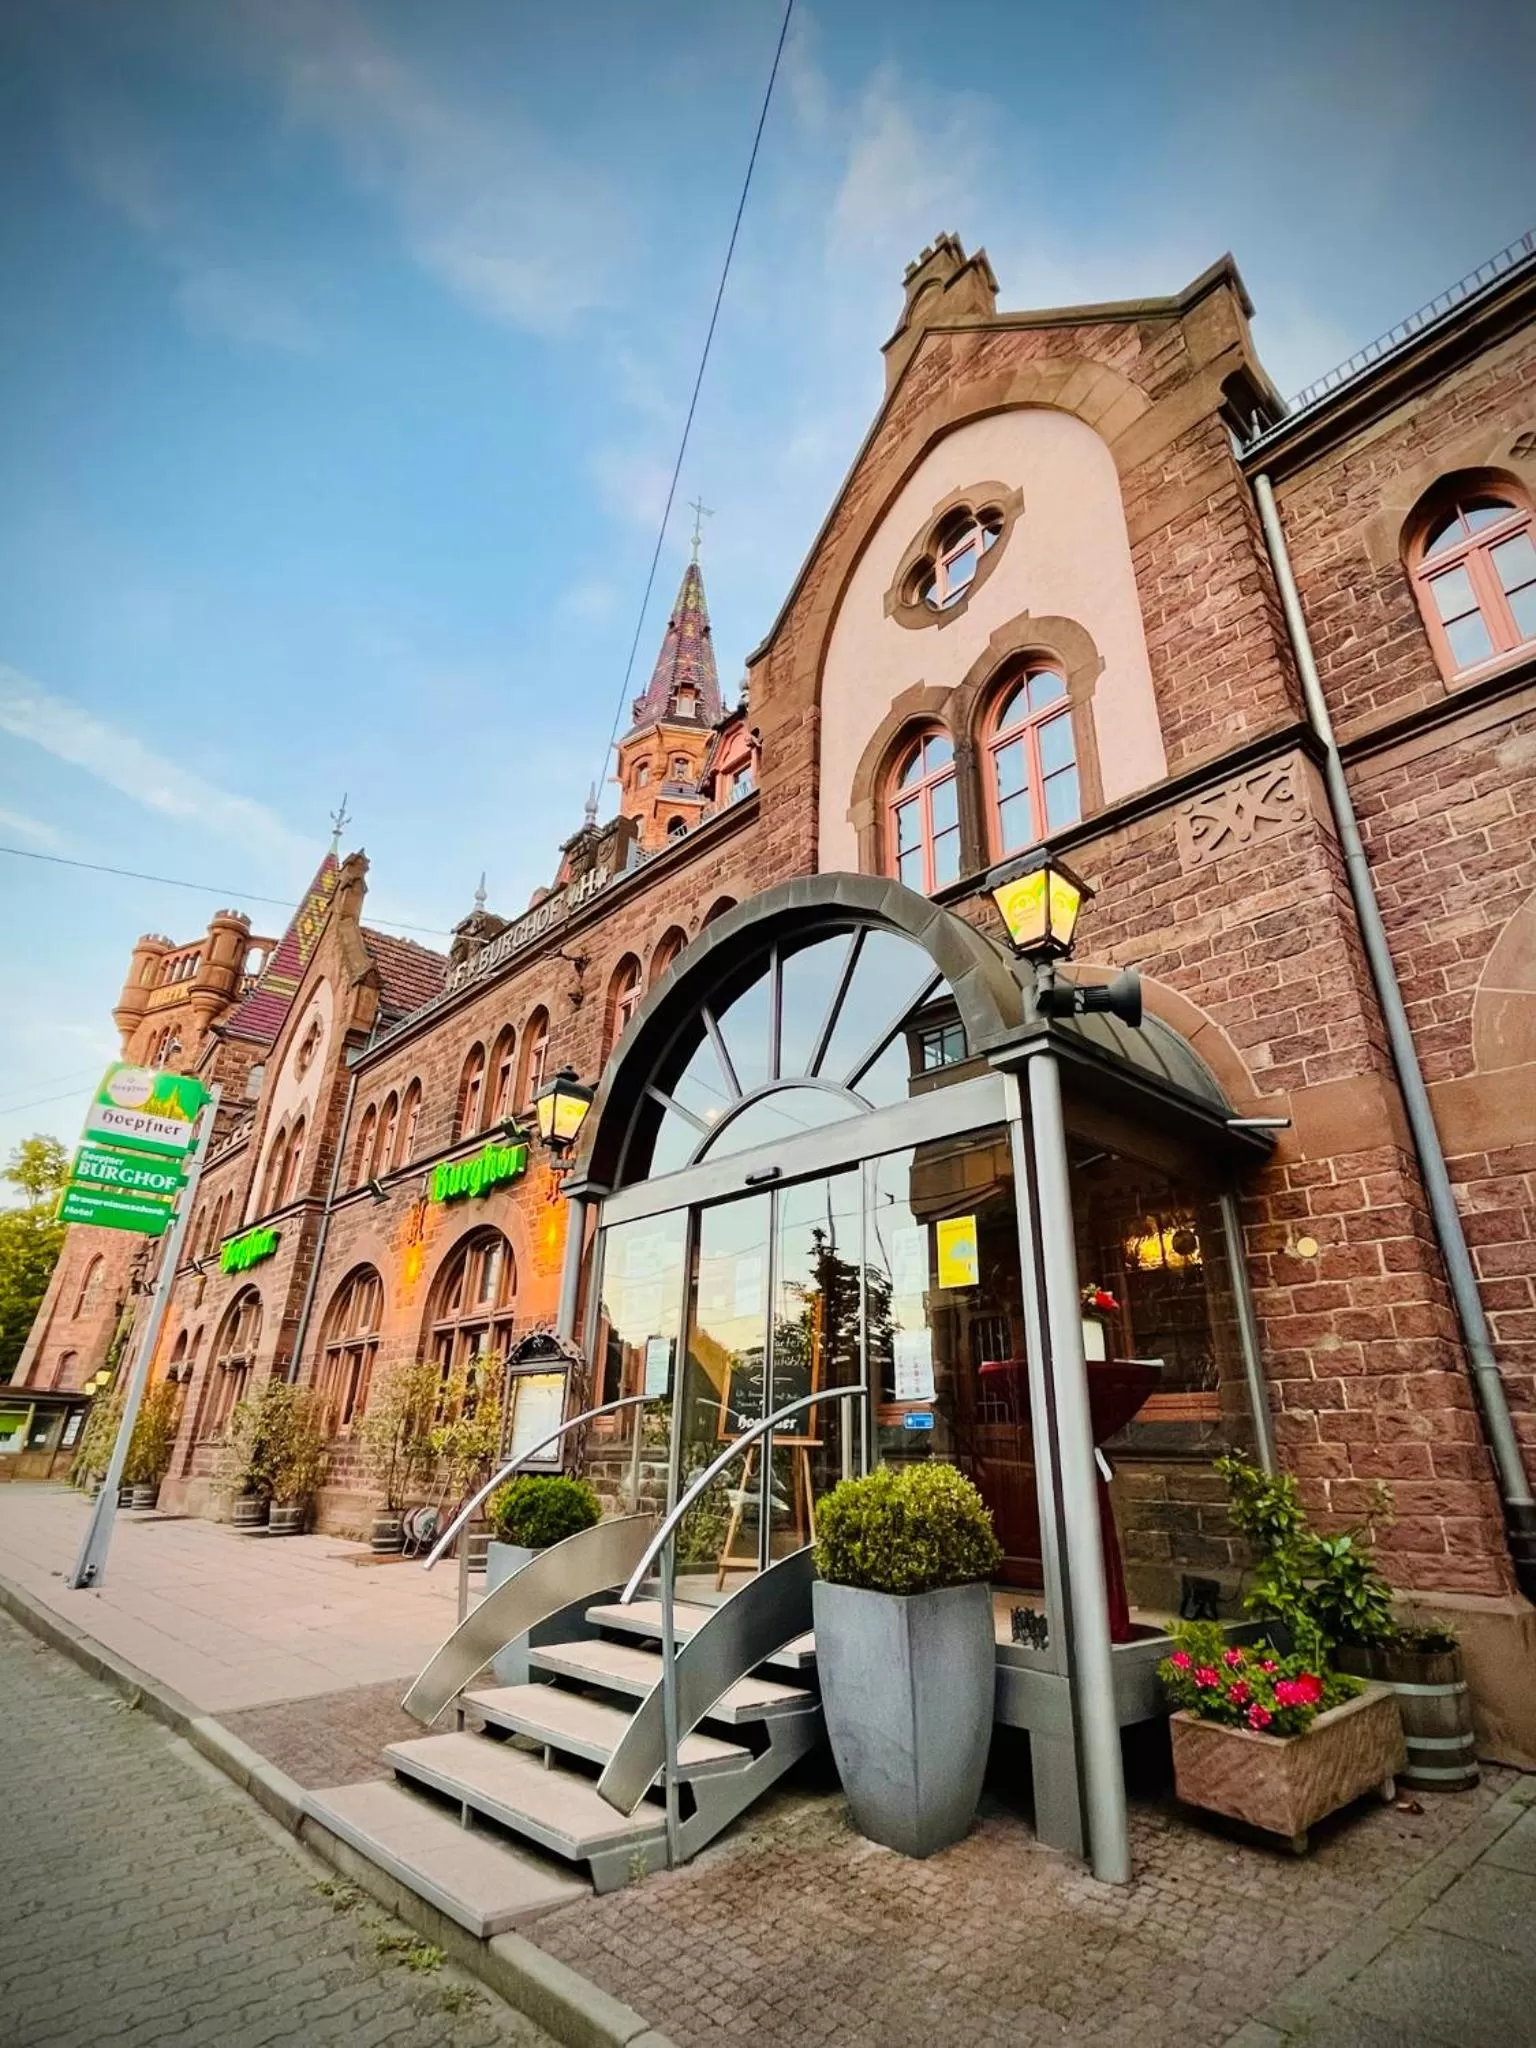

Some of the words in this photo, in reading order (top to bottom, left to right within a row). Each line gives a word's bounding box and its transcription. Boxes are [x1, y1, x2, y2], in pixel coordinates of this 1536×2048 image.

[102, 1109, 183, 1136] hoepfner
[77, 1160, 177, 1190] BURGHOF
[63, 1205, 94, 1217] Hotel
